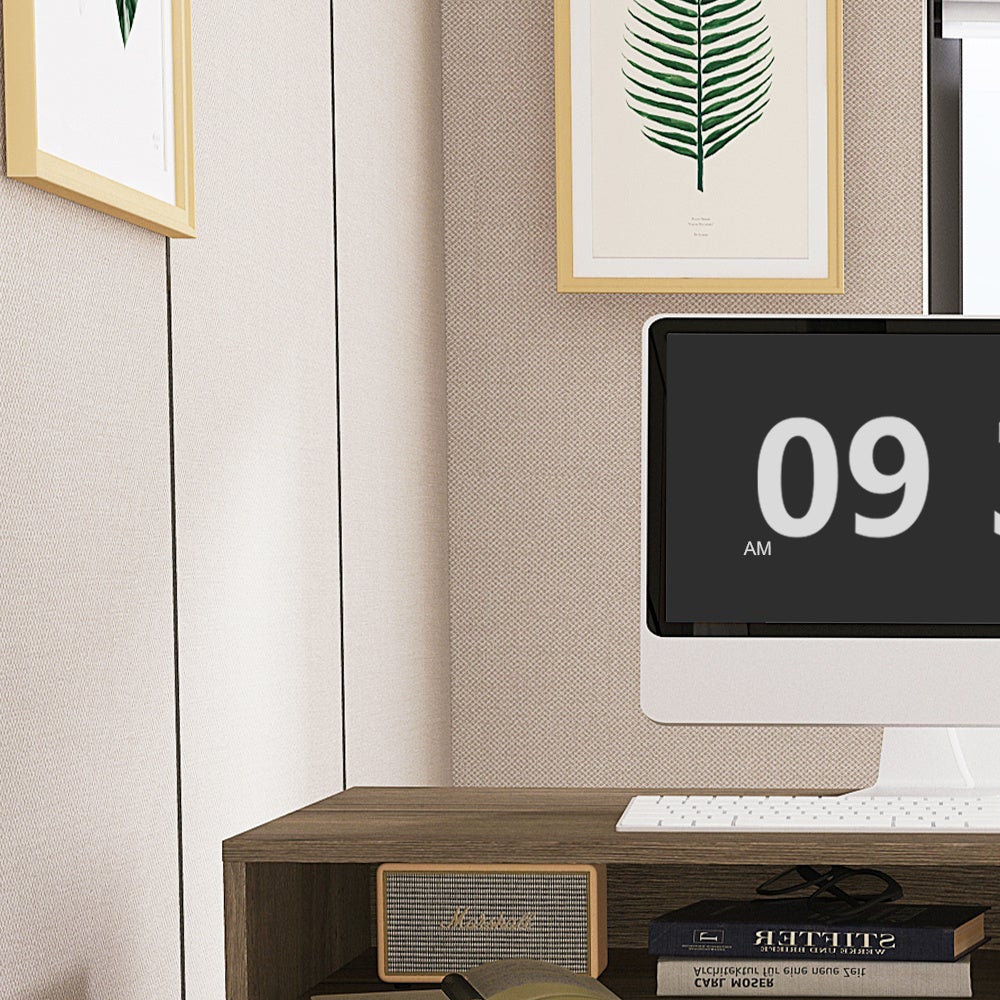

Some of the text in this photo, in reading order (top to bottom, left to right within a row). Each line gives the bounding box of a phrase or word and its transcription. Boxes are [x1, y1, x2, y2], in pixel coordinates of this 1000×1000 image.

[756, 415, 930, 539] 09
[743, 541, 772, 557] AM
[440, 906, 536, 930] Marshall
